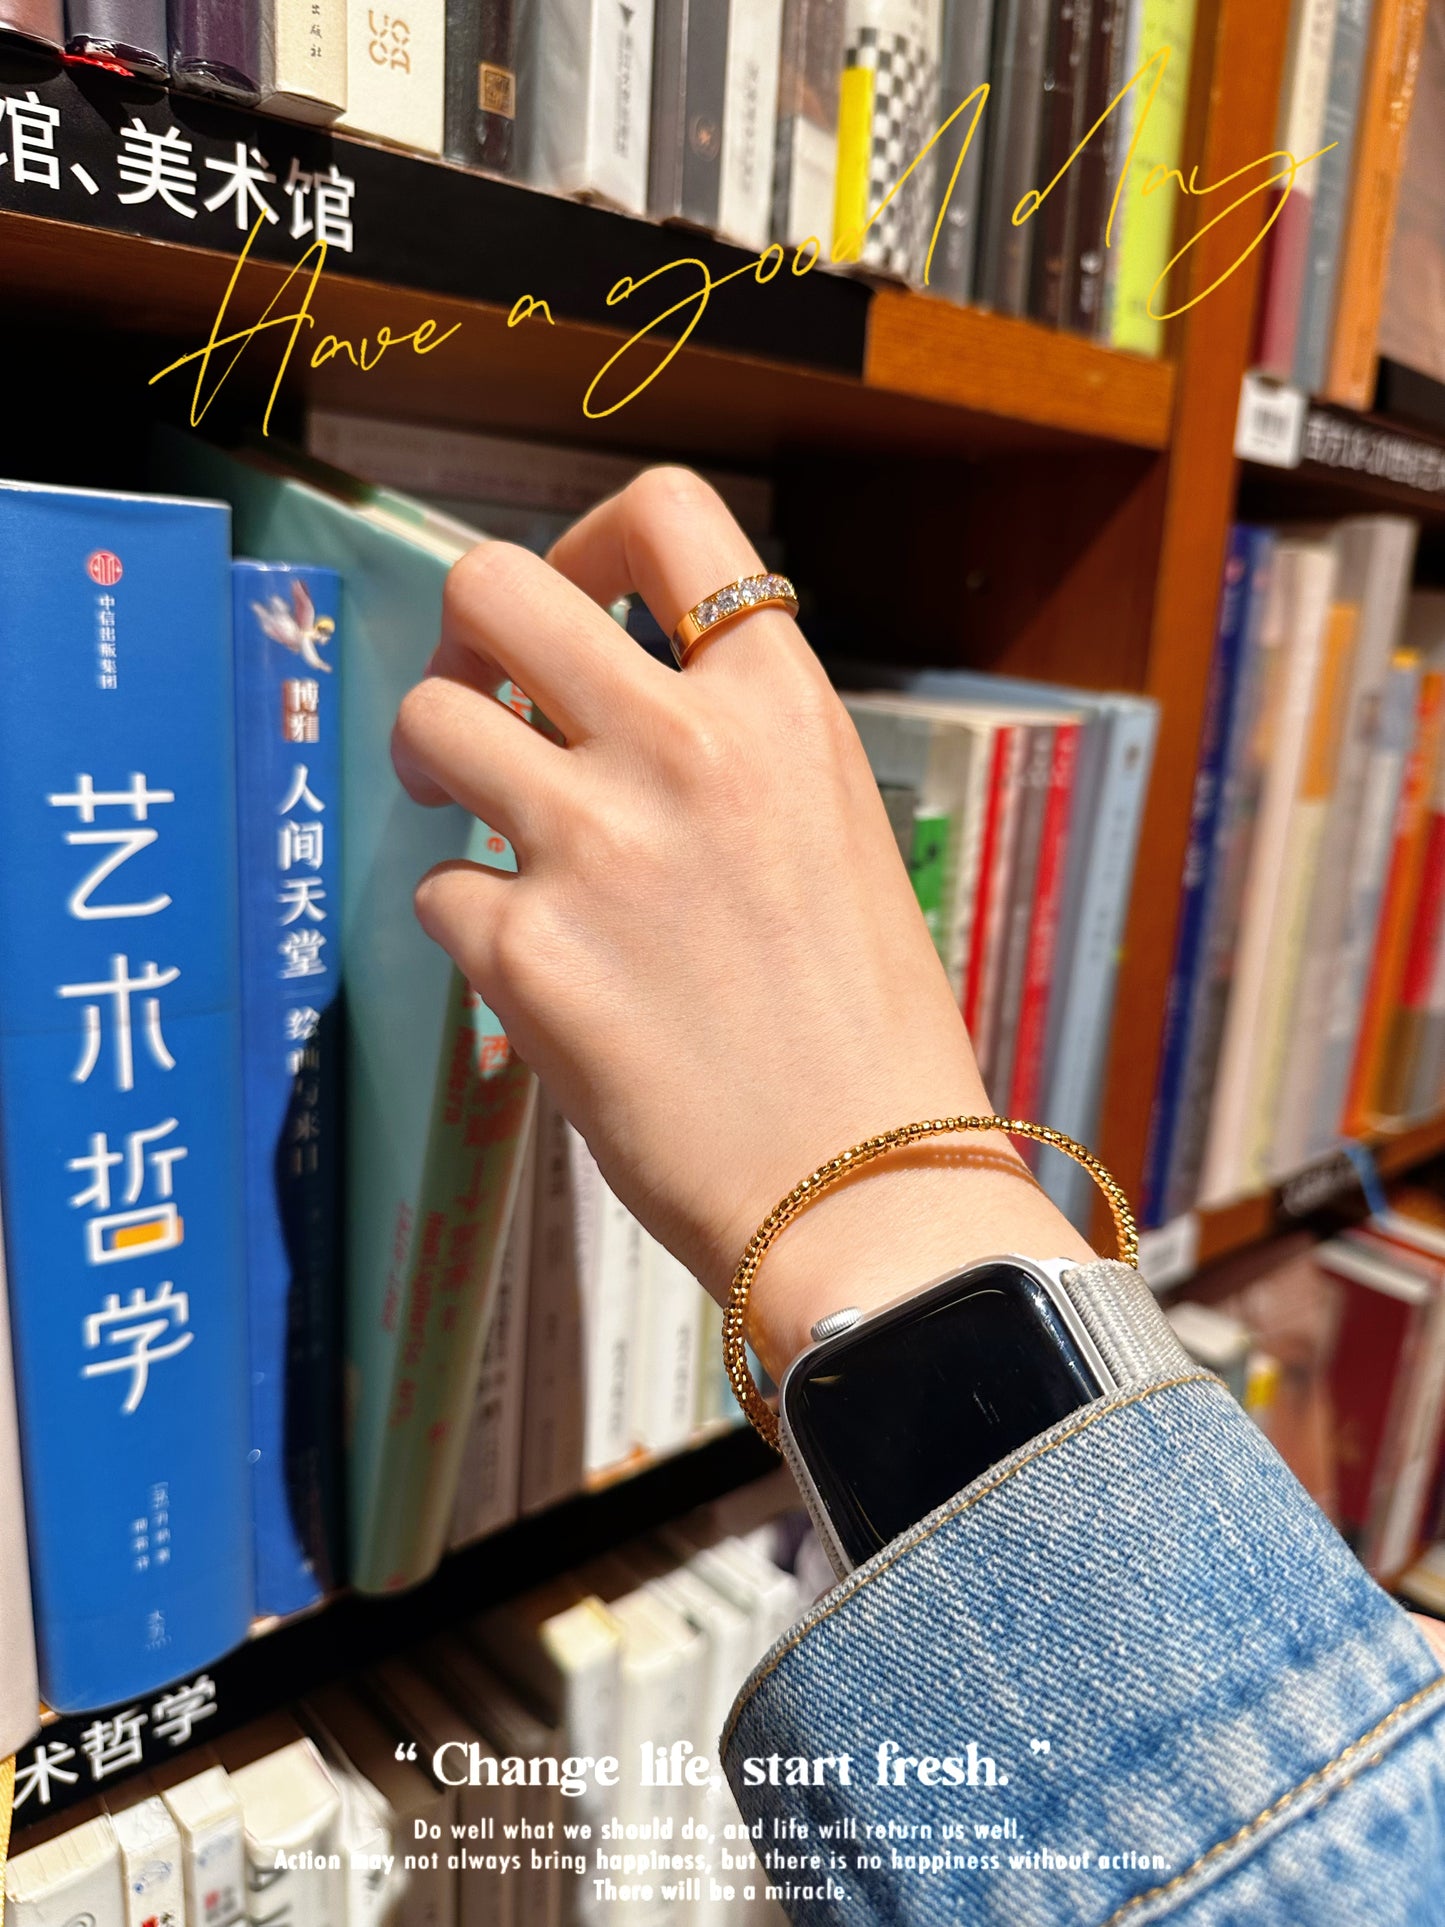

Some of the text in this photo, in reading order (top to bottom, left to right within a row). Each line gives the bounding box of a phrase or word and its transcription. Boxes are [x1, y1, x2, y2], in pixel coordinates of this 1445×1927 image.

[0, 91, 355, 253] 馆、美术馆
[99, 594, 118, 690] 中信出版集团
[277, 764, 328, 980] 人间天堂
[48, 772, 195, 1415] 艺术哲学
[12, 1674, 218, 1811] 术哲学
